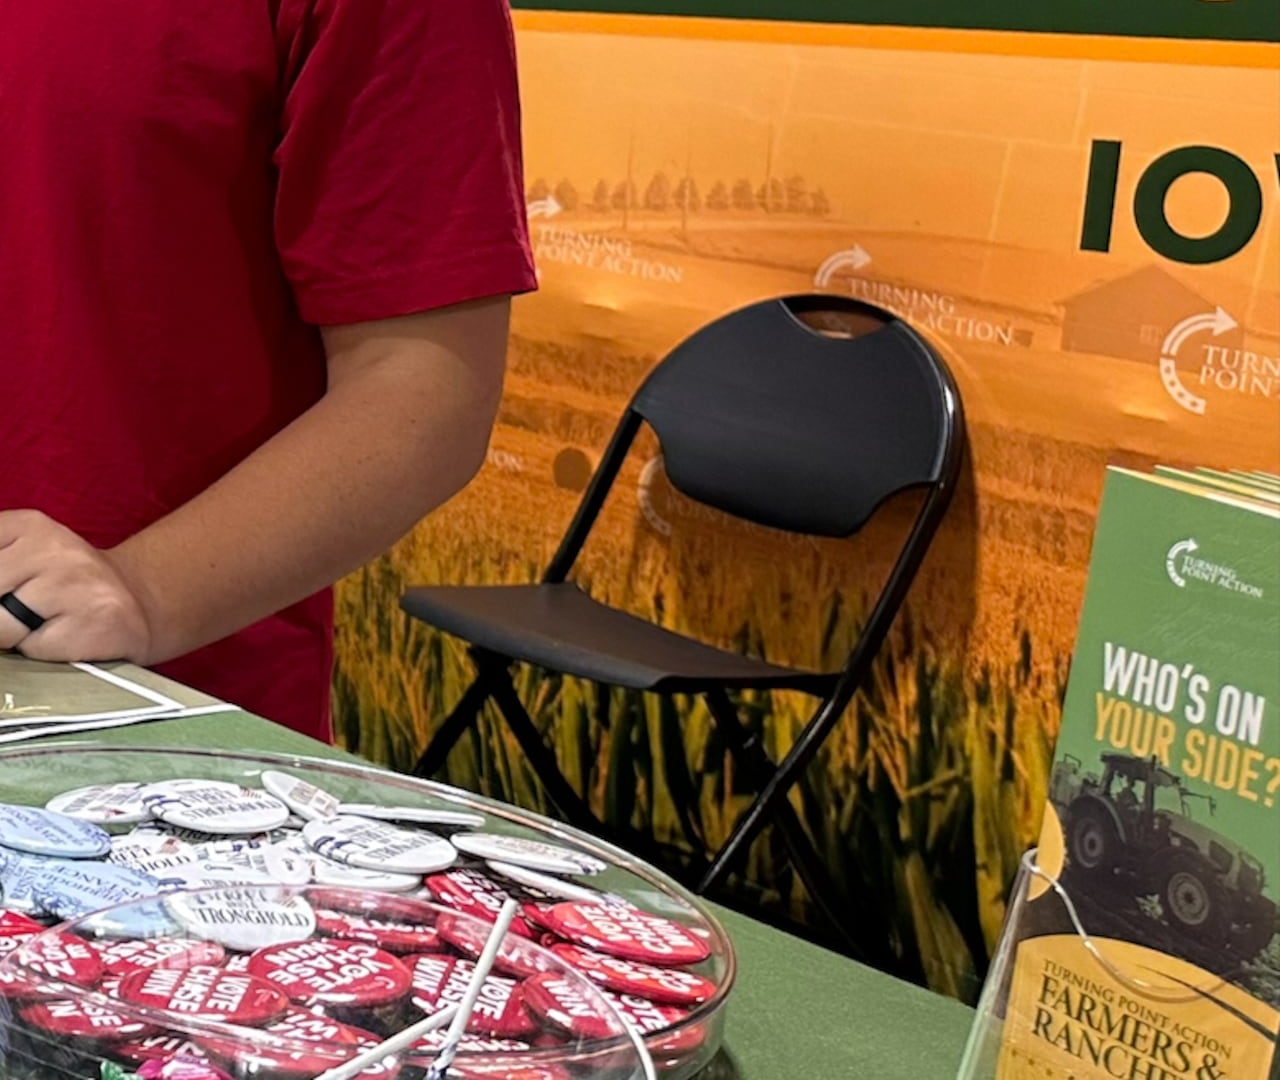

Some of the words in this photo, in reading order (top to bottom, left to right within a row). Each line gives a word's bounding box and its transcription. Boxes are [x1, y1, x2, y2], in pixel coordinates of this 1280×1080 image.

[537, 225, 633, 257] TURNING
[594, 254, 683, 283] ACTION
[847, 276, 955, 314] TURNING
[926, 310, 1014, 346] ACTION
[1181, 553, 1237, 581] TURNING
[1181, 563, 1217, 584] POINT
[1217, 576, 1264, 598] ACTION
[1103, 641, 1210, 726] WHO'S
[1214, 684, 1266, 746] ON
[1094, 691, 1176, 767] YOUR
[1181, 727, 1280, 808] SIDE?
[263, 940, 338, 967] WIN
[266, 944, 379, 986] CHASE
[140, 968, 183, 998] WIN
[168, 965, 220, 1014] CHASE
[206, 974, 252, 1013] VOTE
[302, 956, 394, 993] VOTE
[411, 956, 450, 995] WIN
[1042, 958, 1115, 1006] TURNING
[542, 979, 600, 1019] WIN
[1037, 973, 1195, 1074] FARMERS
[1117, 996, 1170, 1027] POINT
[1169, 1021, 1233, 1062] ACTION
